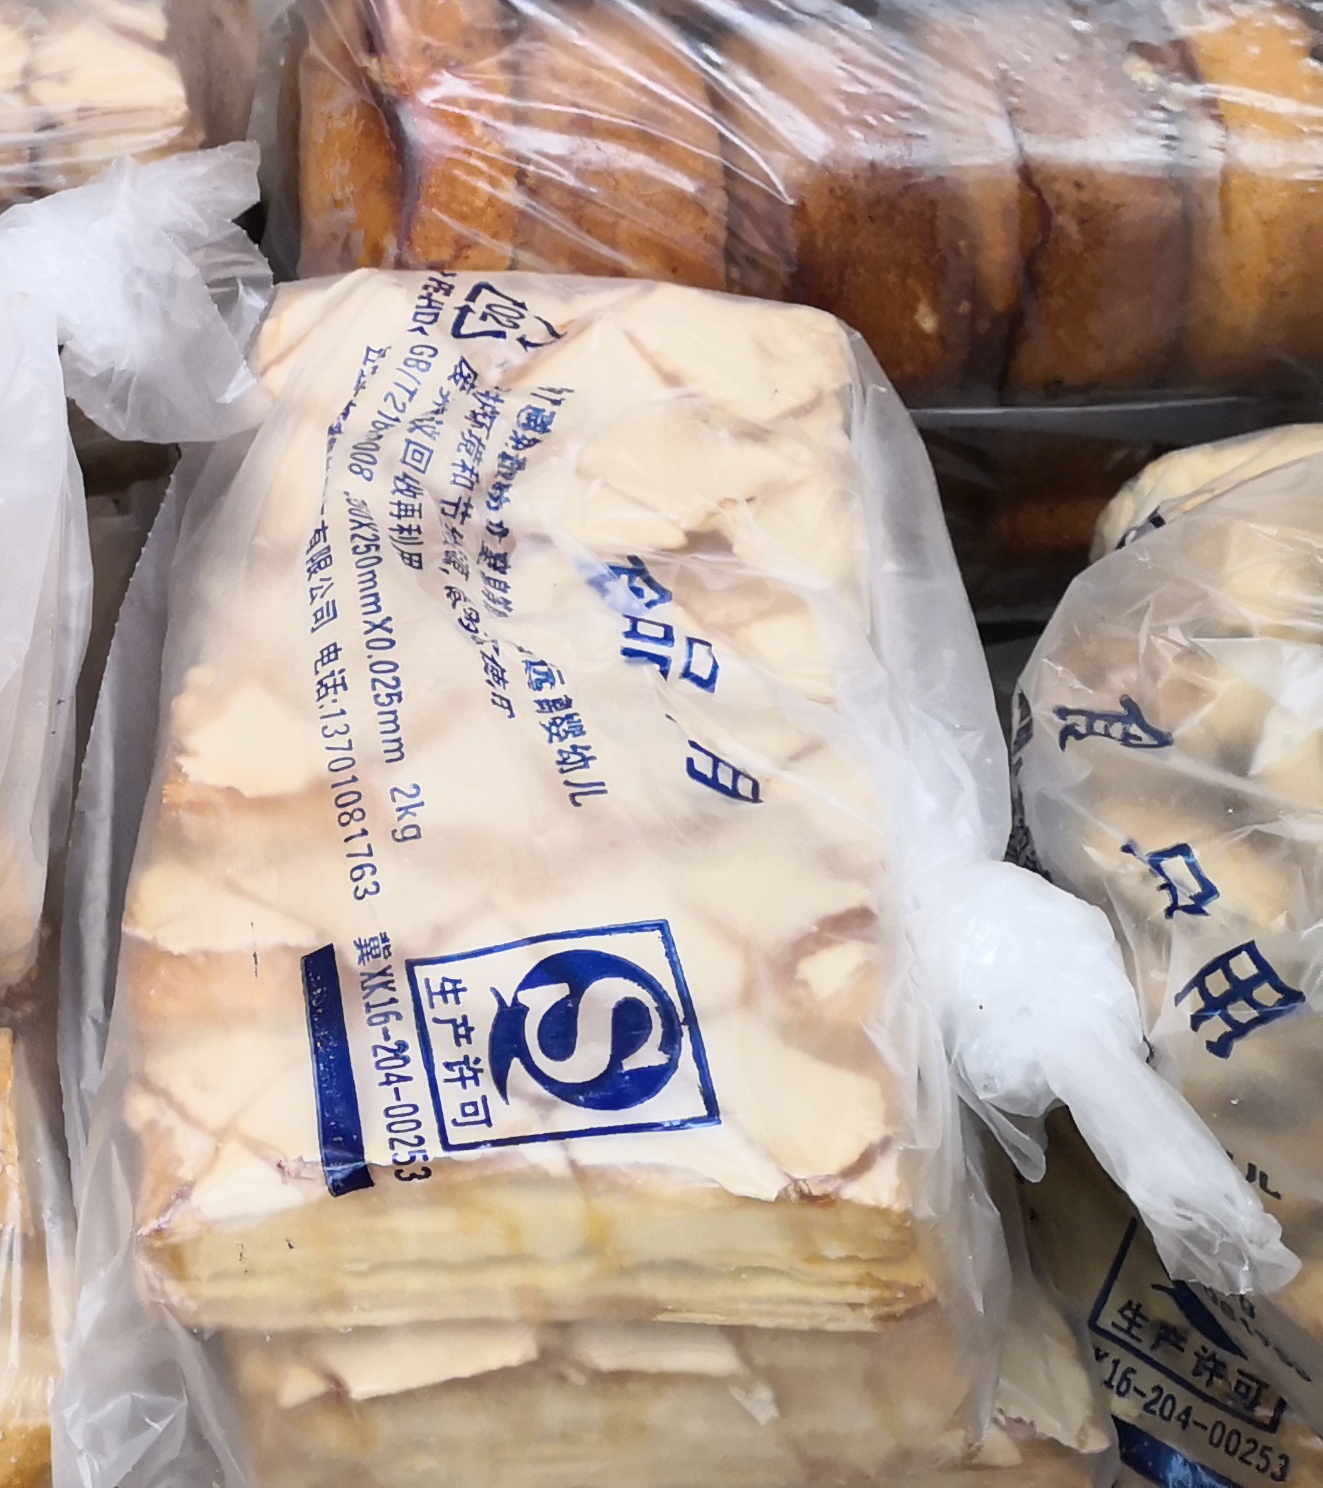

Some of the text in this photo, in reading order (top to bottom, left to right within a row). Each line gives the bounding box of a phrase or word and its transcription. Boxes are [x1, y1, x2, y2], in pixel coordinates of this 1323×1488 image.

[389, 783, 424, 844] 2kg
[423, 975, 492, 1129] 生产许可
